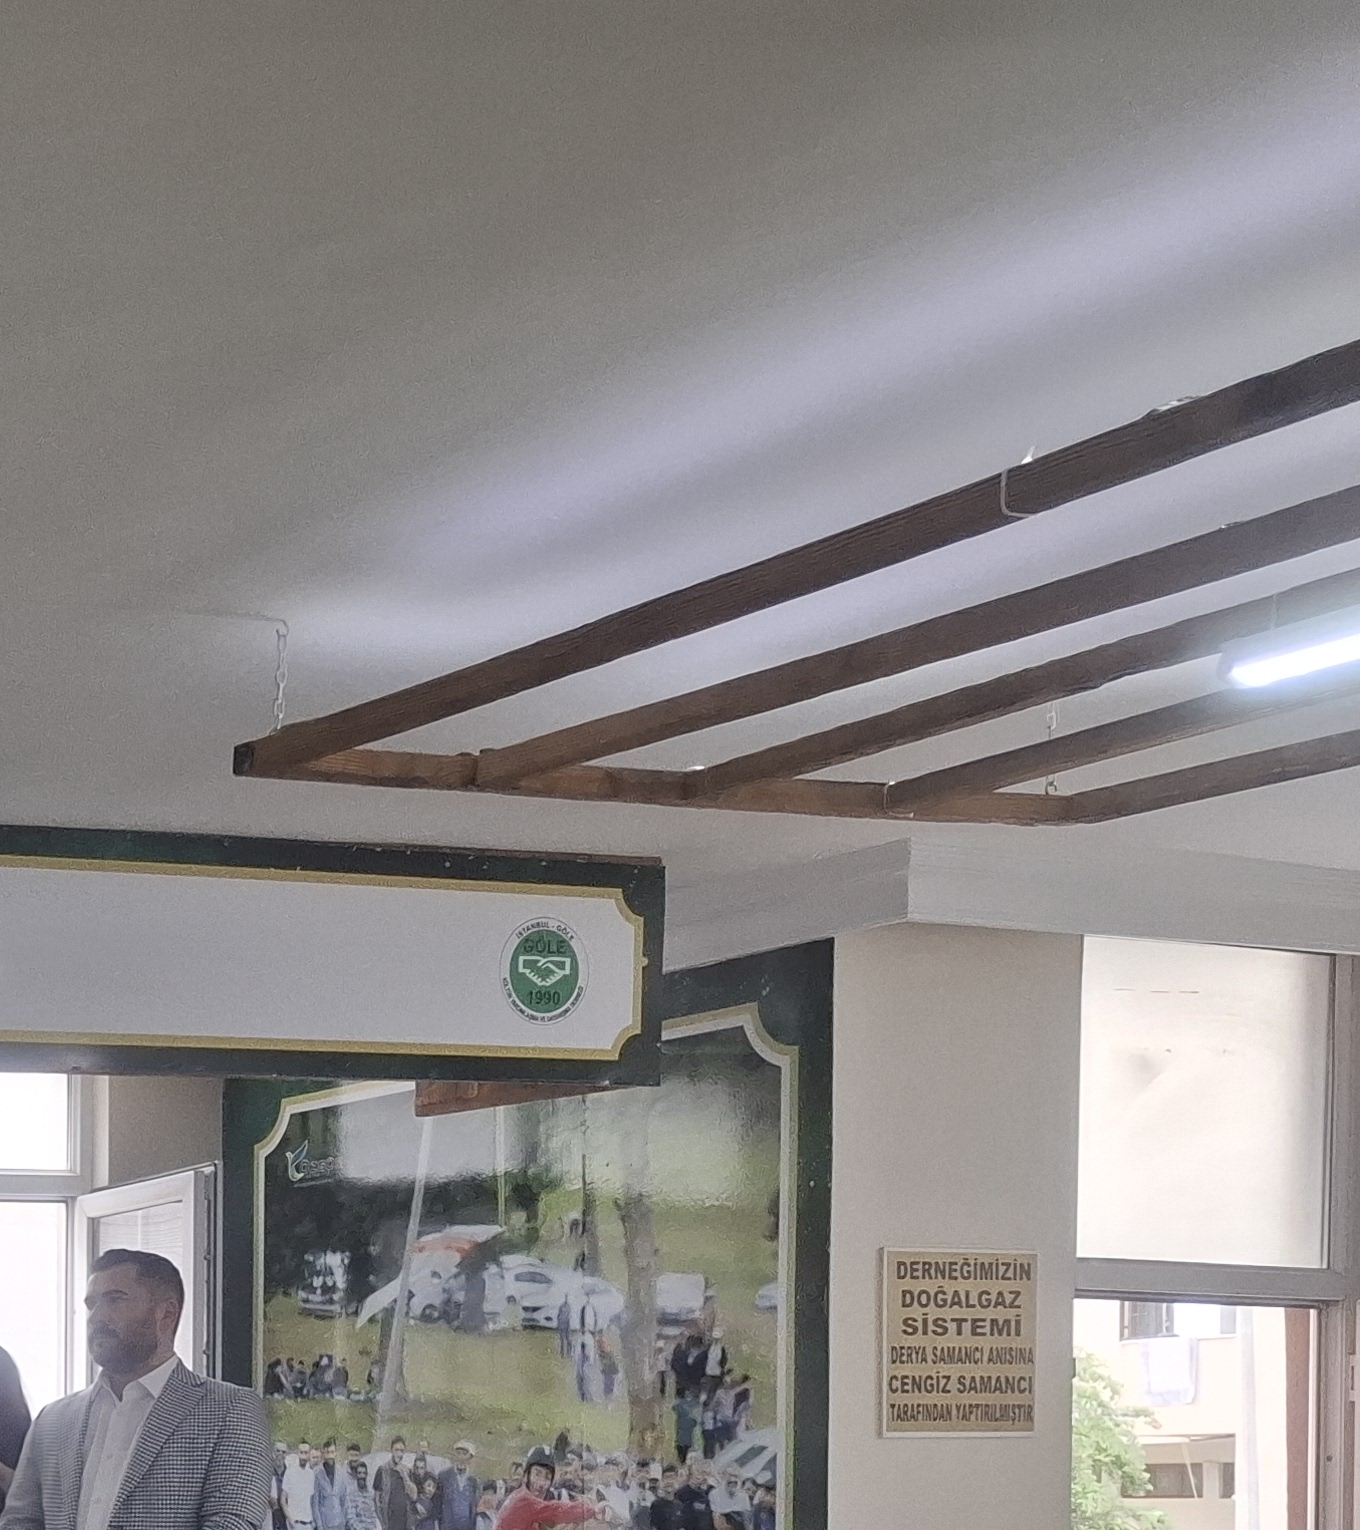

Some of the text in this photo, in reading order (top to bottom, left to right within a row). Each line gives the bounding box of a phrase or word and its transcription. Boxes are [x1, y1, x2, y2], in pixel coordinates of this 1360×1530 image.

[523, 934, 567, 954] GÖLE
[526, 990, 561, 1006] 1990
[896, 1257, 1031, 1281] DERNEĞİMİZİN
[901, 1285, 1022, 1309] DOĞALGAZ
[901, 1312, 1022, 1337] SİSTEMİ
[890, 1345, 928, 1365] DERYA
[931, 1345, 984, 1365] SAMANCI
[888, 1371, 1032, 1394] CENGİZ SAMANCI
[889, 1402, 952, 1422] TARAFINDAN
